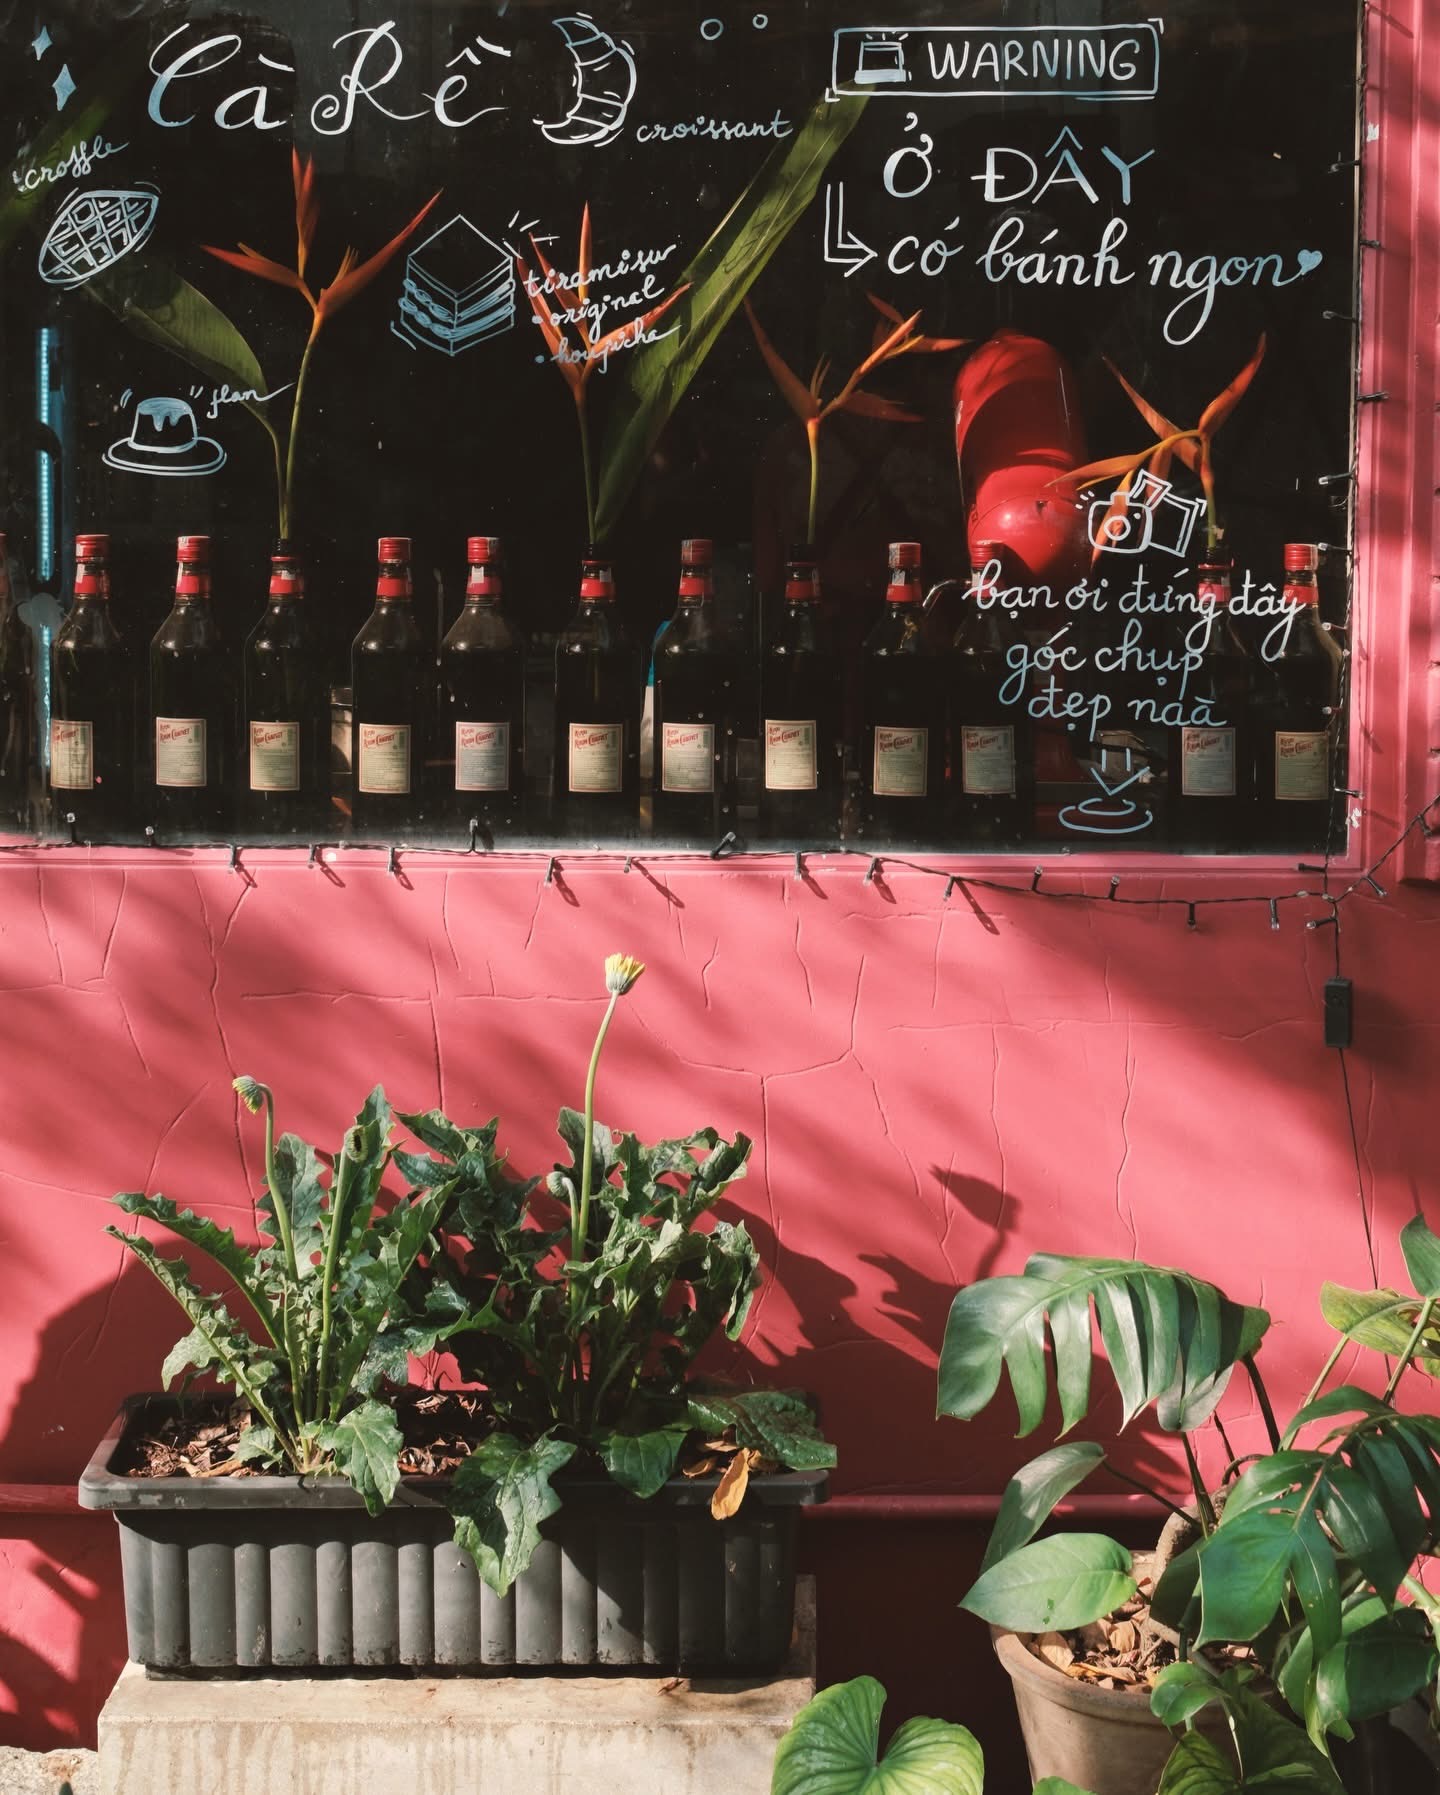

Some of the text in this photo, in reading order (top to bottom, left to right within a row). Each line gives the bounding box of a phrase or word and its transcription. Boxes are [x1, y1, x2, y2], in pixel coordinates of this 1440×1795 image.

[927, 37, 1141, 82] WARNING
[636, 108, 794, 143] croissant
[883, 111, 1156, 205] Ở ĐÂY
[24, 135, 130, 190] croffle
[523, 244, 677, 298] tiramisu
[887, 216, 1306, 345] có bánh ngon
[550, 274, 665, 345] original
[206, 383, 297, 420] flan
[961, 558, 1059, 620] bạn
[1118, 563, 1223, 655] đứng
[1228, 569, 1307, 662] đây
[998, 618, 1203, 705] góc chụp
[1027, 674, 1112, 743] đẹp
